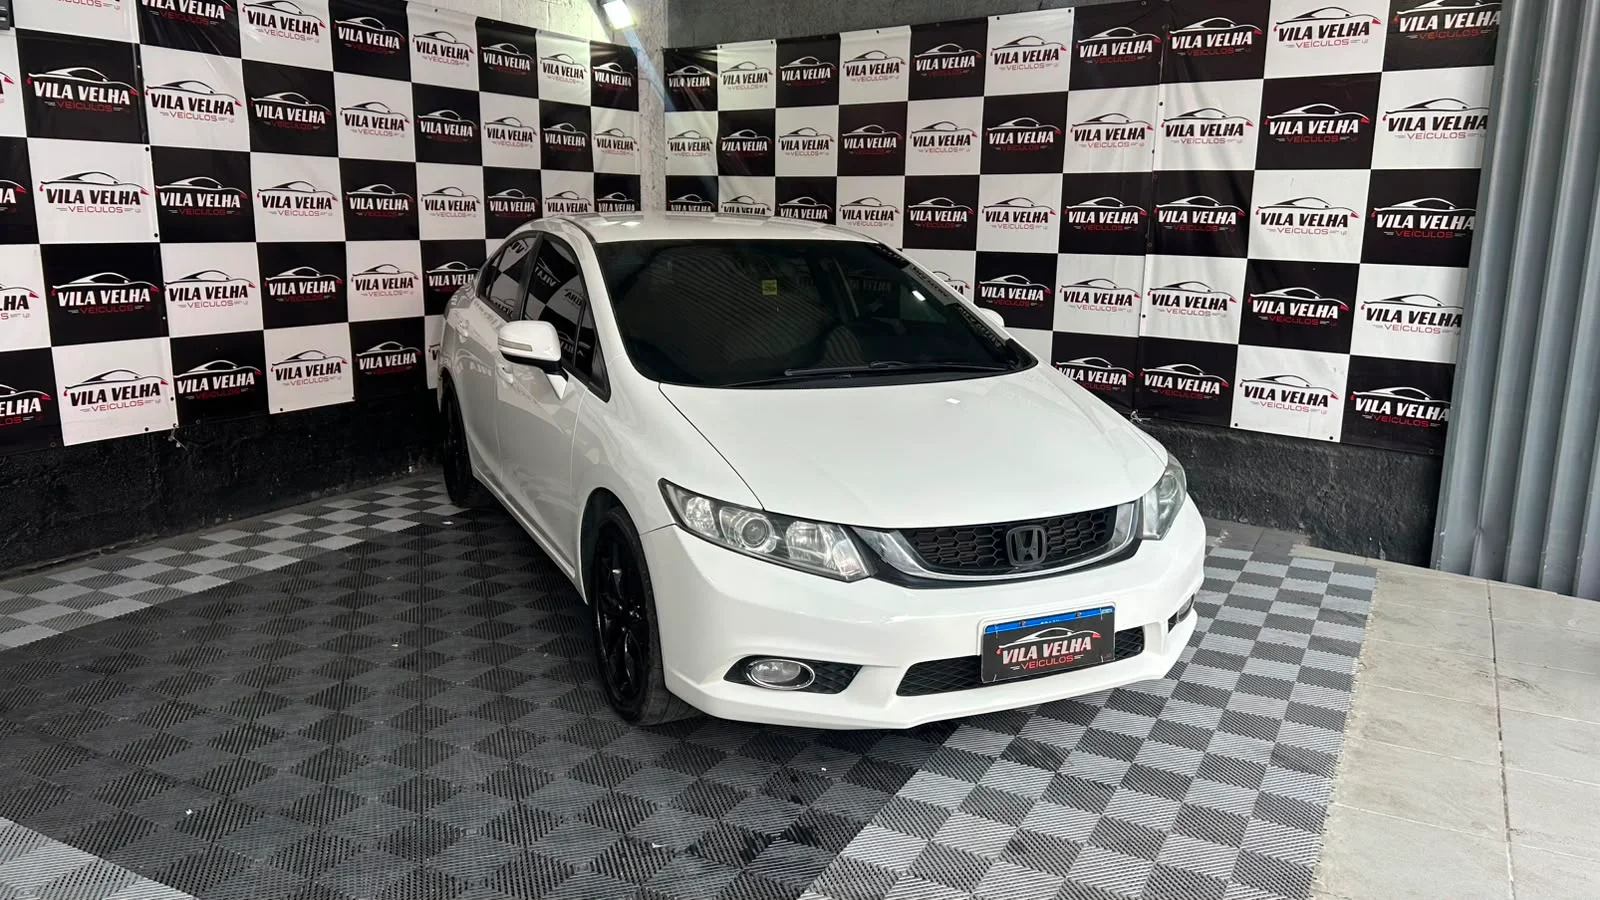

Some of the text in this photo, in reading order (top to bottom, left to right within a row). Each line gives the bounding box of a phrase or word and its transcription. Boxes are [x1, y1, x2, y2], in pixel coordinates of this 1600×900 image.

[179, 0, 225, 19] VELHA
[248, 10, 319, 36] VILA VELHA
[1400, 11, 1500, 32] VILA VELHA
[338, 27, 363, 42] VILA
[366, 32, 400, 49] VELHA
[1279, 22, 1369, 41] VILA VELHA
[1172, 32, 1252, 49] VILA VELHA
[416, 40, 469, 61] VILA VELHA
[994, 48, 1058, 65] VILA VELHA
[1080, 40, 1152, 58] VILA VELHA
[484, 52, 530, 70] VILA VELHA
[917, 56, 975, 71] VILA VELHA
[782, 68, 830, 81] VILA VELHA
[846, 62, 899, 76] VILA VELHA
[34, 82, 130, 104] VILA VELHA
[151, 94, 234, 115] VILA VELHA
[256, 104, 325, 124] VILA VELHA
[344, 114, 404, 131] VILA VELHA
[421, 121, 472, 137] VILA VELHA
[1270, 120, 1358, 134] VILA VELHA
[1388, 115, 1487, 131] VILA VELHA
[487, 128, 532, 142] VILA VELHA
[990, 132, 1053, 144] VILA VELHA
[1075, 128, 1145, 142] VILA VELHA
[1166, 124, 1243, 137] VILA VELHA
[545, 133, 585, 146] VILA VELHA
[722, 141, 767, 151] VILA VELHA
[782, 140, 829, 150] VILA VELHA
[844, 138, 896, 148] VILA VELHA
[914, 135, 970, 147] VILA VELHA
[46, 189, 140, 205] VILA VELHA
[160, 192, 240, 208] VILA VELHA
[262, 196, 332, 209] VILA VELHA
[350, 198, 408, 210] VILA VELHA
[425, 200, 476, 212] VILA VELHA
[490, 201, 535, 212] VILA VELHA
[843, 210, 894, 221] VILA VELHA
[910, 210, 967, 222] VILA VELHA
[986, 211, 1048, 223] VILA VELHA
[1069, 212, 1138, 224] VILA VELHA
[1159, 211, 1236, 224] VILA VELHA
[1261, 213, 1348, 227] VILA VELHA
[1377, 214, 1474, 229] VILA VELHA
[269, 280, 335, 295] VILA VELHA
[356, 278, 413, 290] VILA VELHA
[429, 274, 475, 286] VILA VELH
[58, 289, 150, 306] VILA VELHA
[169, 286, 248, 301] VILA VELHA
[982, 286, 1043, 300] VILA VELHA
[1064, 291, 1132, 306] VILA VELHA
[1152, 294, 1227, 311] VILA VELHA
[1253, 300, 1338, 318] VILA VELHA
[1367, 308, 1462, 327] VILA VELHA
[360, 353, 416, 370] VILA VELHA
[276, 362, 341, 380] VILA VELHA
[1088, 371, 1126, 385] VELHA
[178, 372, 254, 394] VILA VELHA
[1145, 374, 1219, 394] VILA VELHA
[70, 383, 160, 406] VILA VELHA
[1244, 386, 1328, 407] VILA VELHA
[0, 398, 41, 415] ELHA
[1356, 398, 1448, 420] VILA VELHA
[1003, 637, 1091, 664] VILA VELHA
